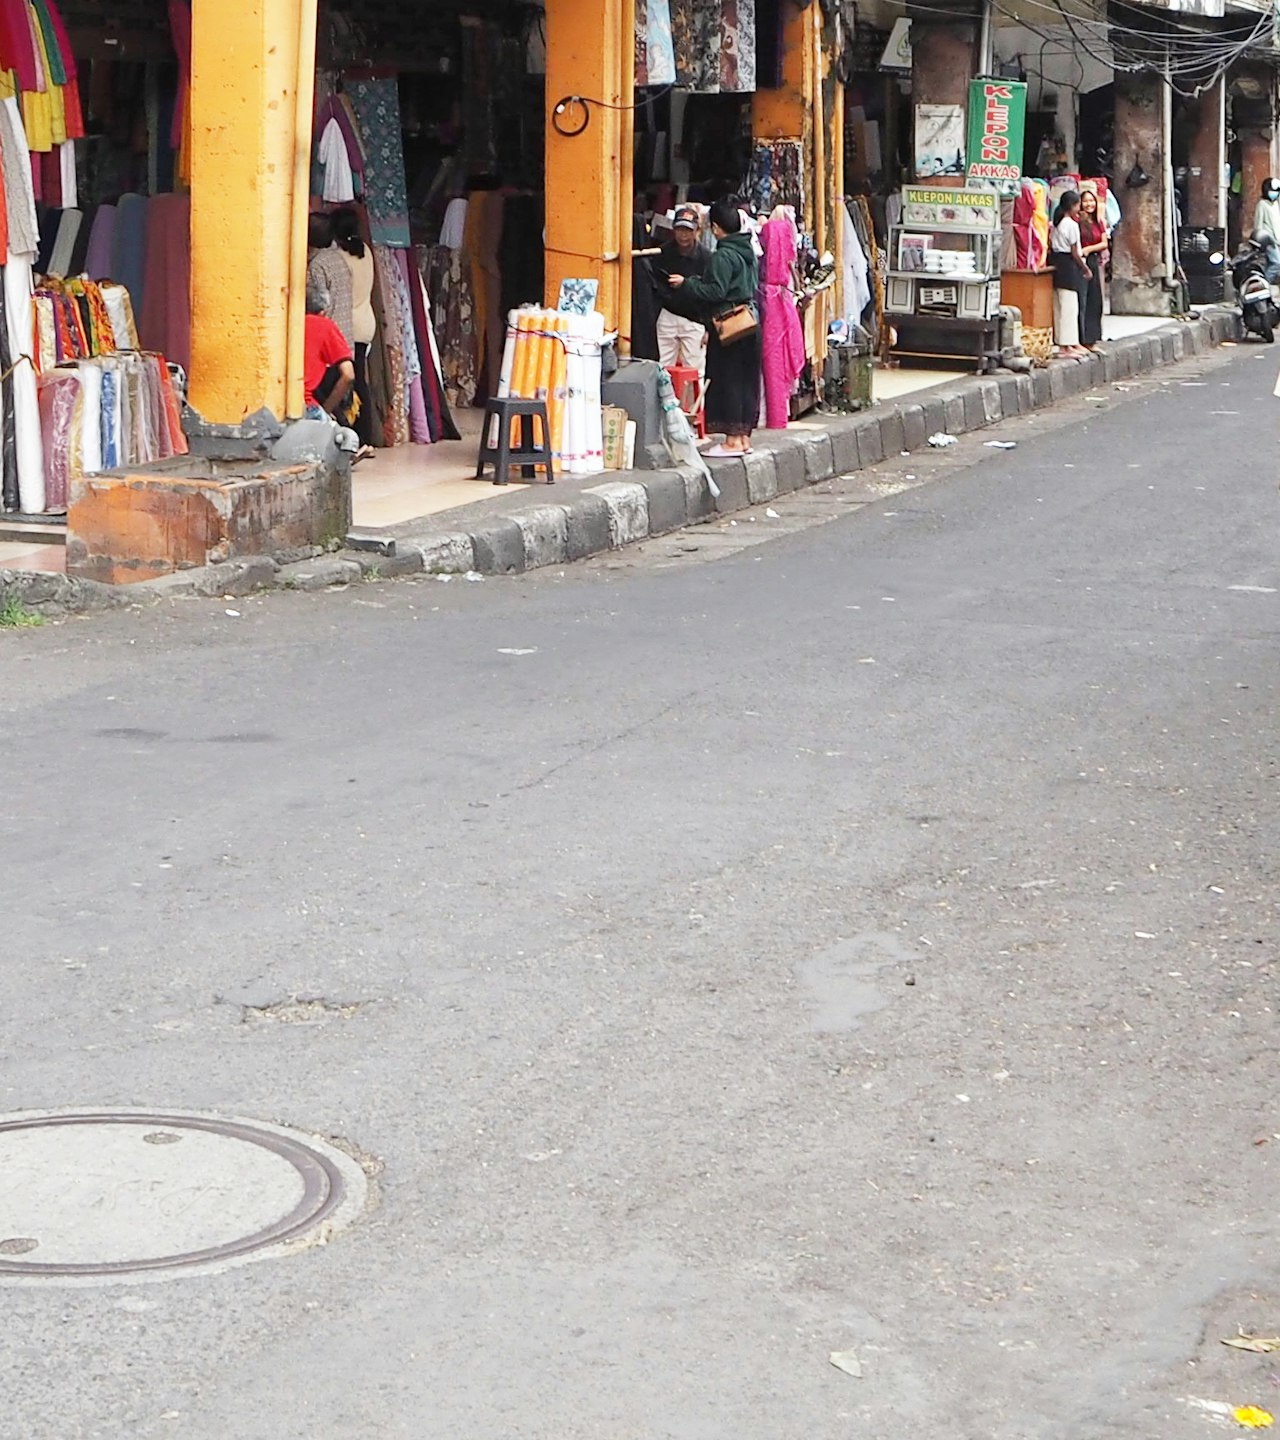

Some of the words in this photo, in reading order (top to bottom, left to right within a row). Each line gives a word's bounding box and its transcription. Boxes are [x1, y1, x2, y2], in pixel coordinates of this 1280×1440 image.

[981, 84, 1013, 161] KLEPON
[969, 162, 1021, 179] AKKAS
[909, 190, 953, 204] KLEPON
[956, 193, 994, 207] AKKAS
